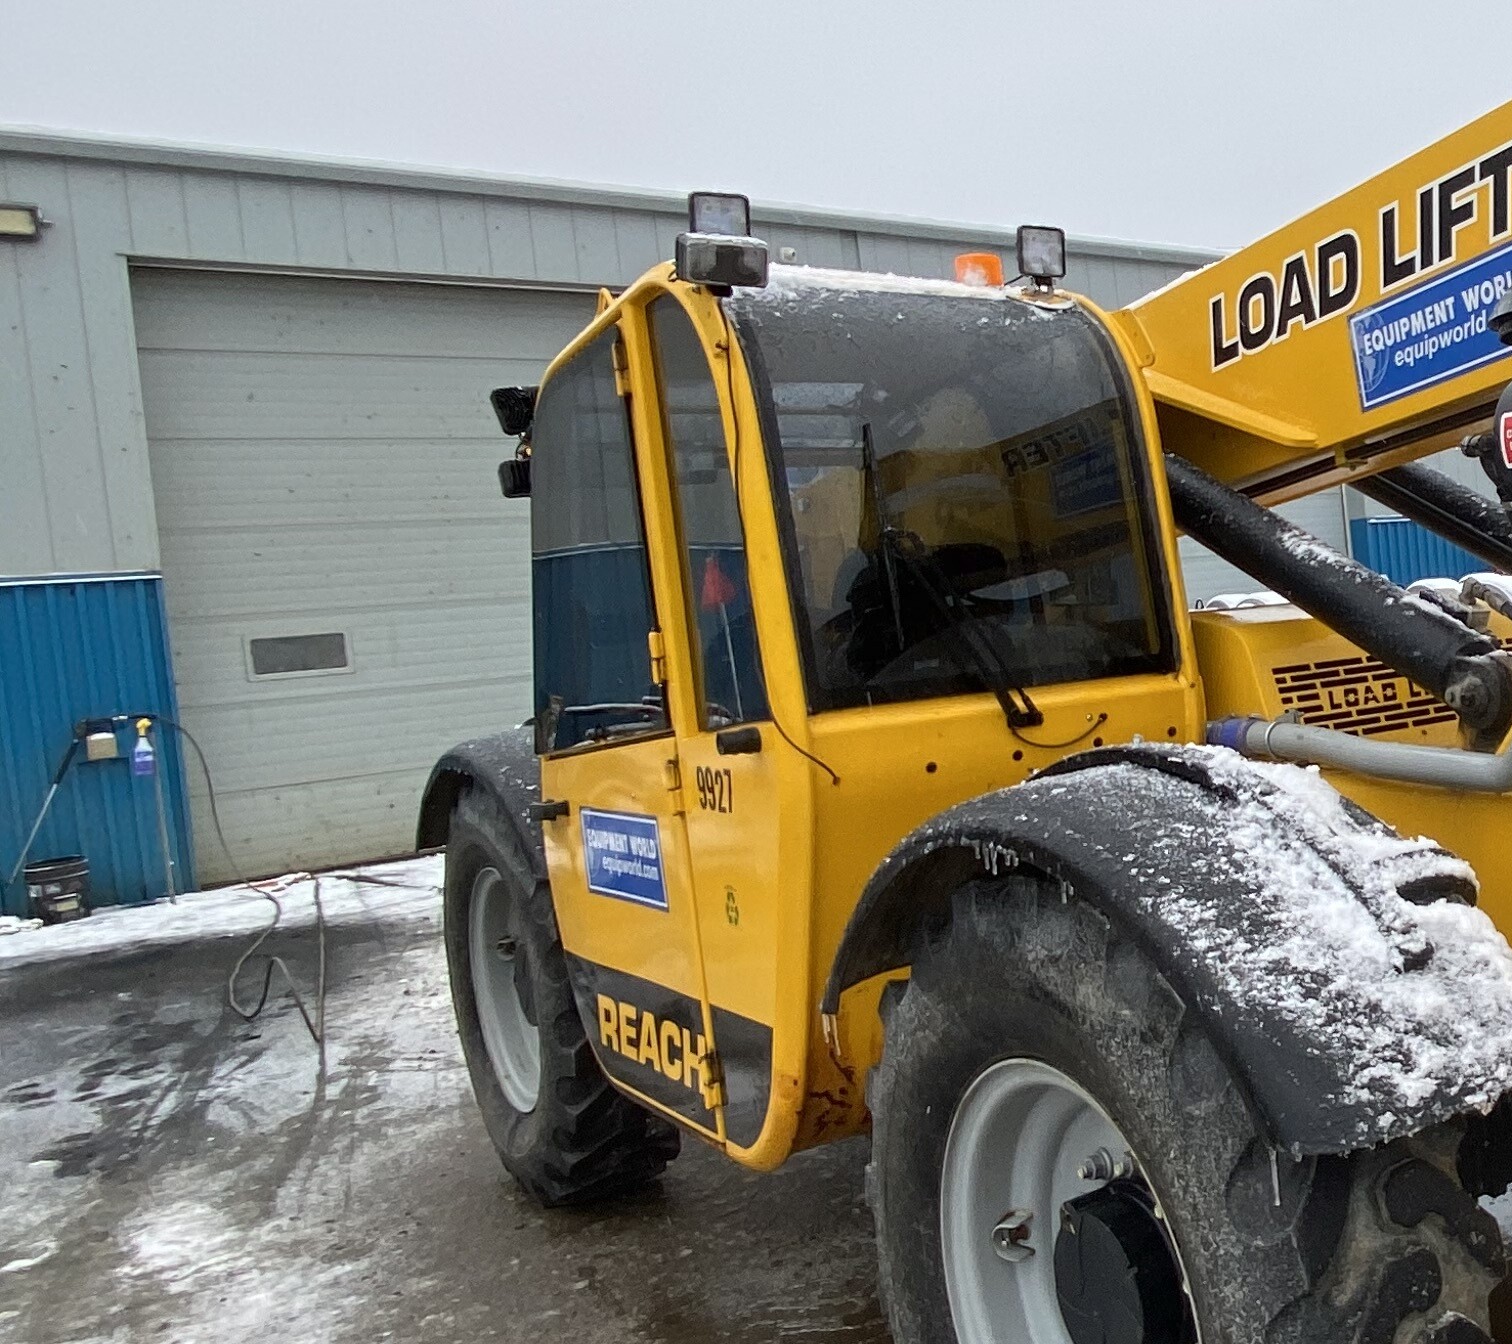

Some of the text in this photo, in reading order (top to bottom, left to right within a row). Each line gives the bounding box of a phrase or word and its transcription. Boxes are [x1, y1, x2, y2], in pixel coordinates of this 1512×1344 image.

[1210, 230, 1360, 371] LOAD
[1363, 296, 1455, 356] EQUIPMENT
[1328, 681, 1397, 710] LOAD
[696, 765, 733, 814] 9927
[586, 828, 657, 860] EQUIPMENT WORLD
[602, 854, 659, 881] equipworld.com
[597, 993, 706, 1096] REACH
